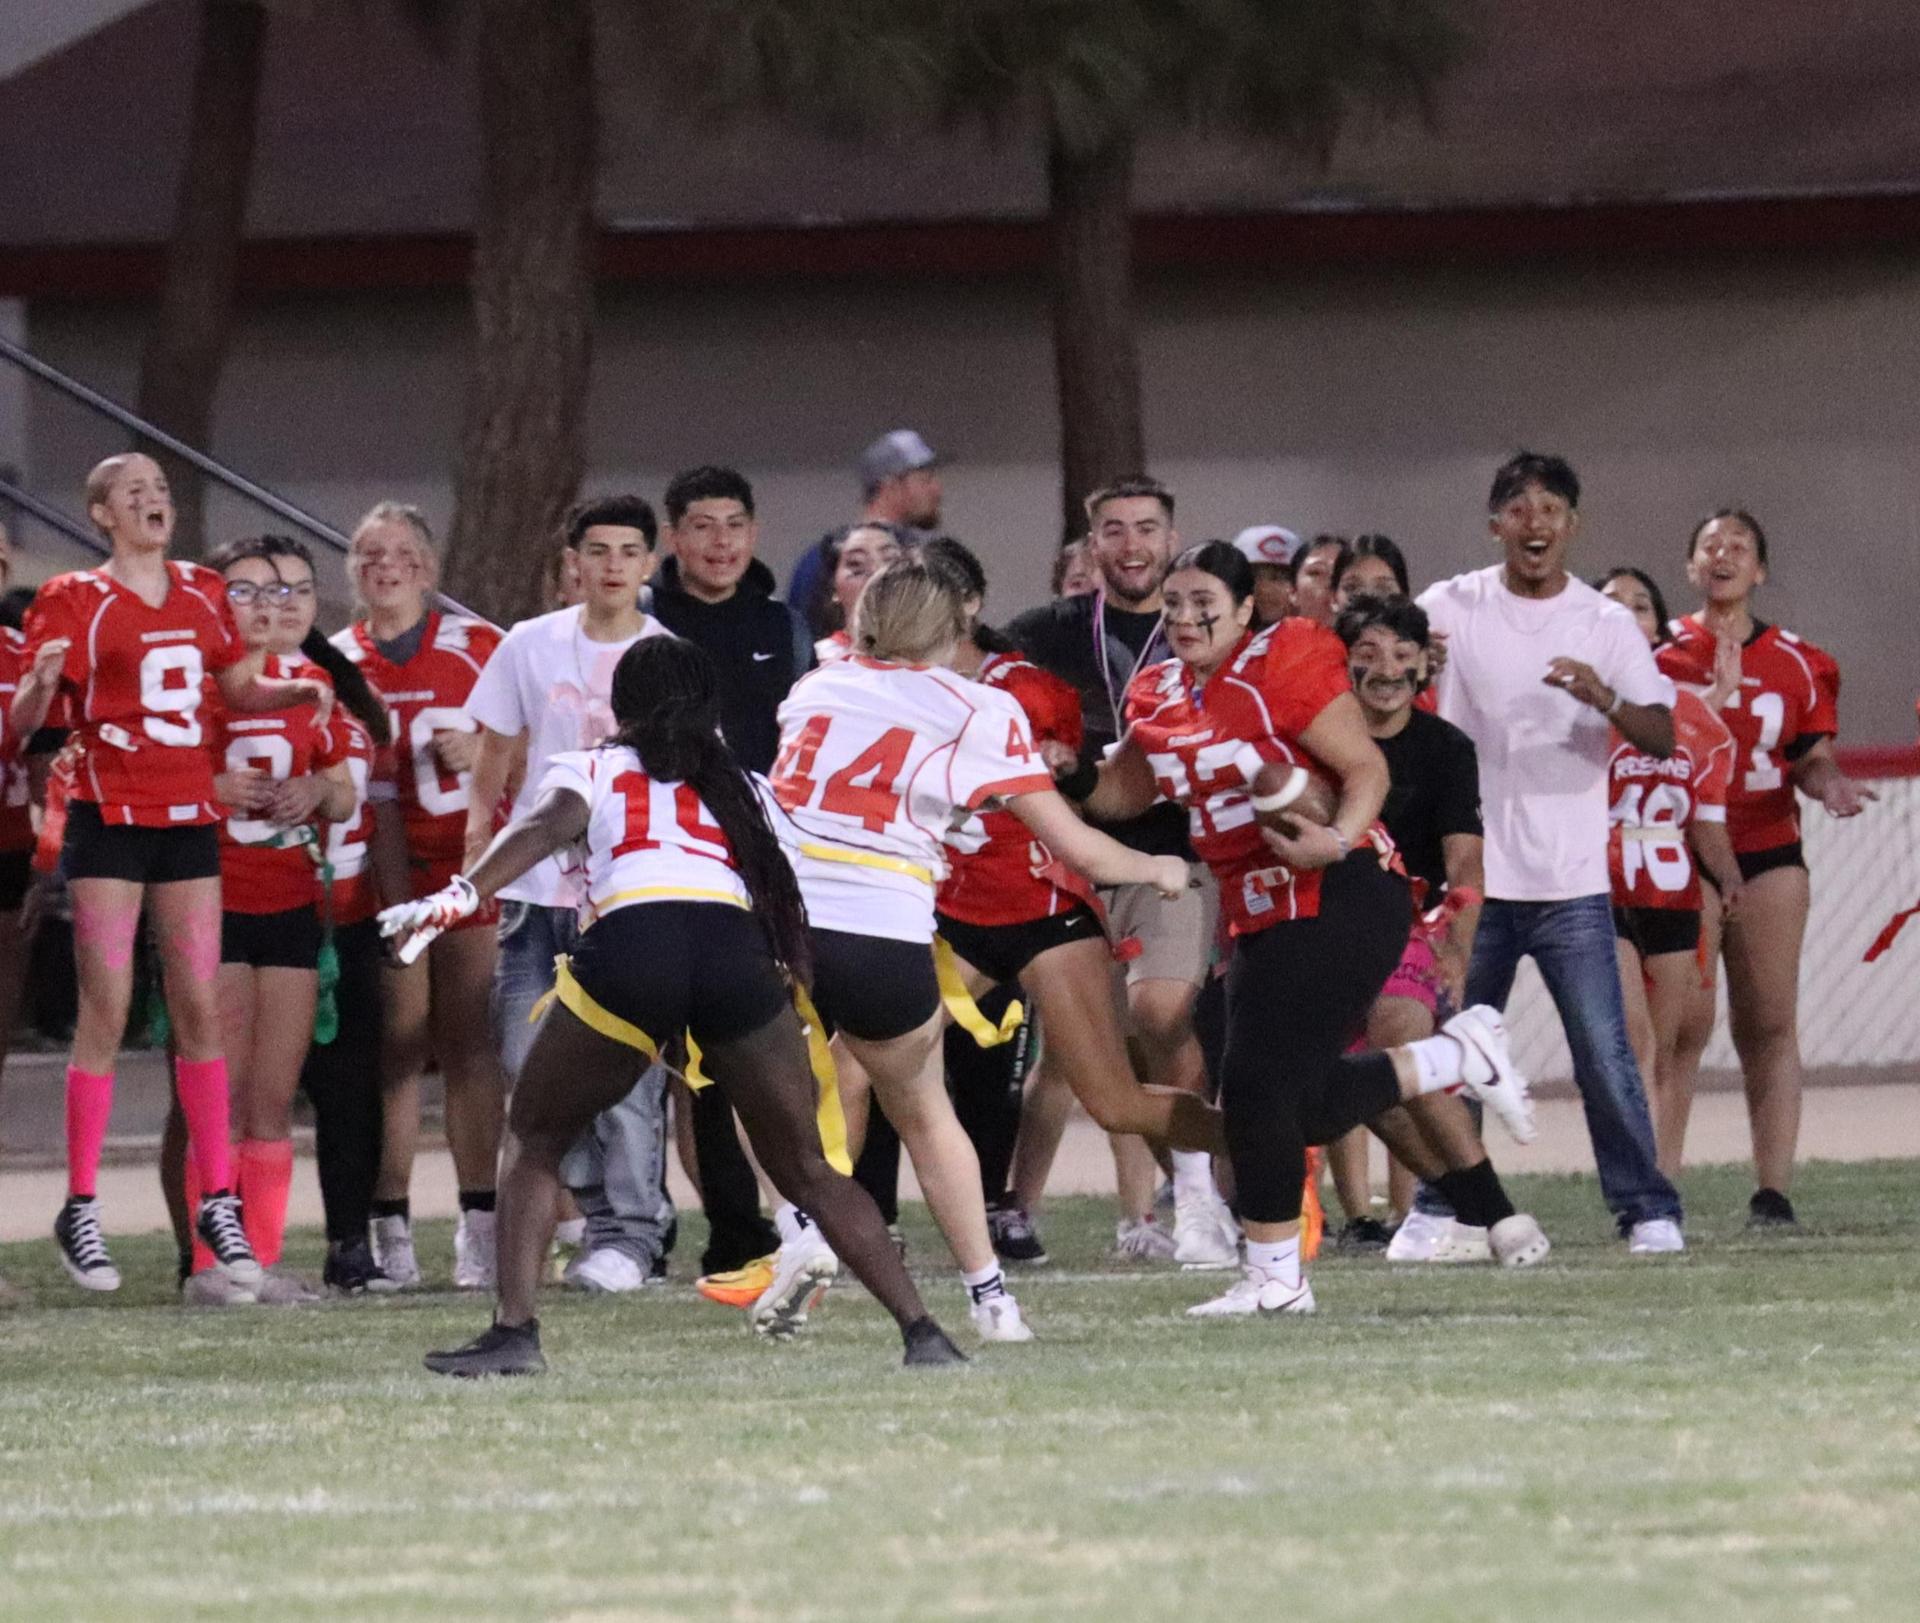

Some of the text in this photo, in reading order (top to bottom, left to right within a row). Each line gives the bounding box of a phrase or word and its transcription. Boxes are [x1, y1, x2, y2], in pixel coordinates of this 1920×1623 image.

[140, 644, 204, 748] 9
[1005, 717, 1031, 765] 4
[768, 713, 916, 835] 44
